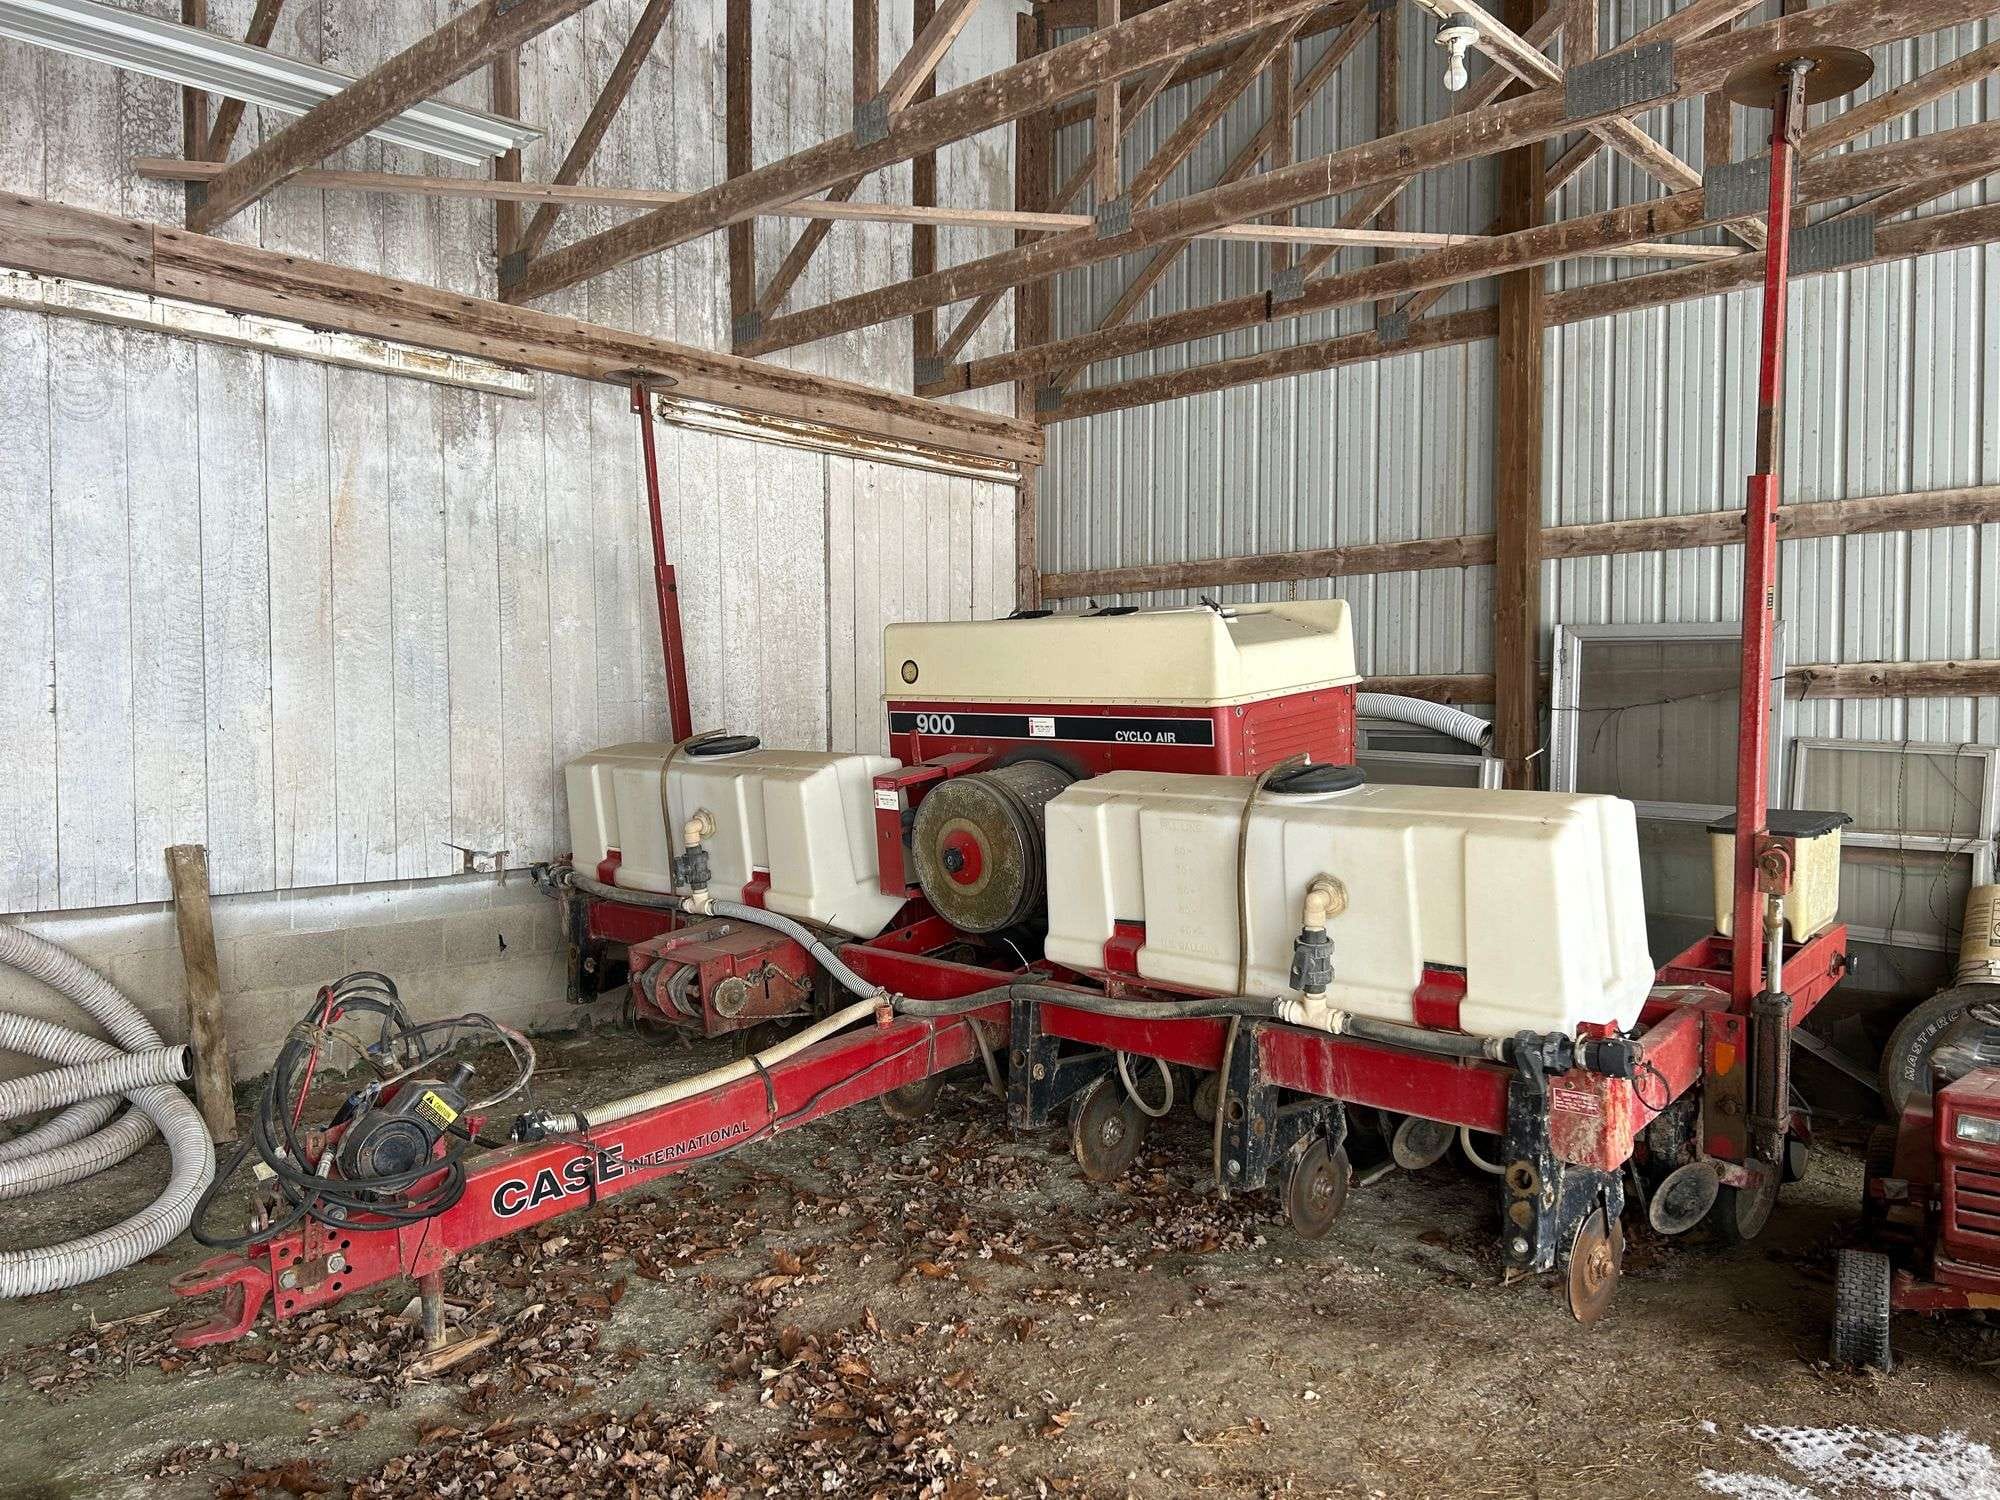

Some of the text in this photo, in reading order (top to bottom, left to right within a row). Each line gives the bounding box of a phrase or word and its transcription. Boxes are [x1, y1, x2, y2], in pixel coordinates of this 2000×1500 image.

[916, 713, 955, 735] 900
[1115, 730, 1177, 744] CYCLO AIR
[1904, 1009, 1961, 1081] MASTERC
[491, 1120, 751, 1218] CASE INTERNATIONAL
